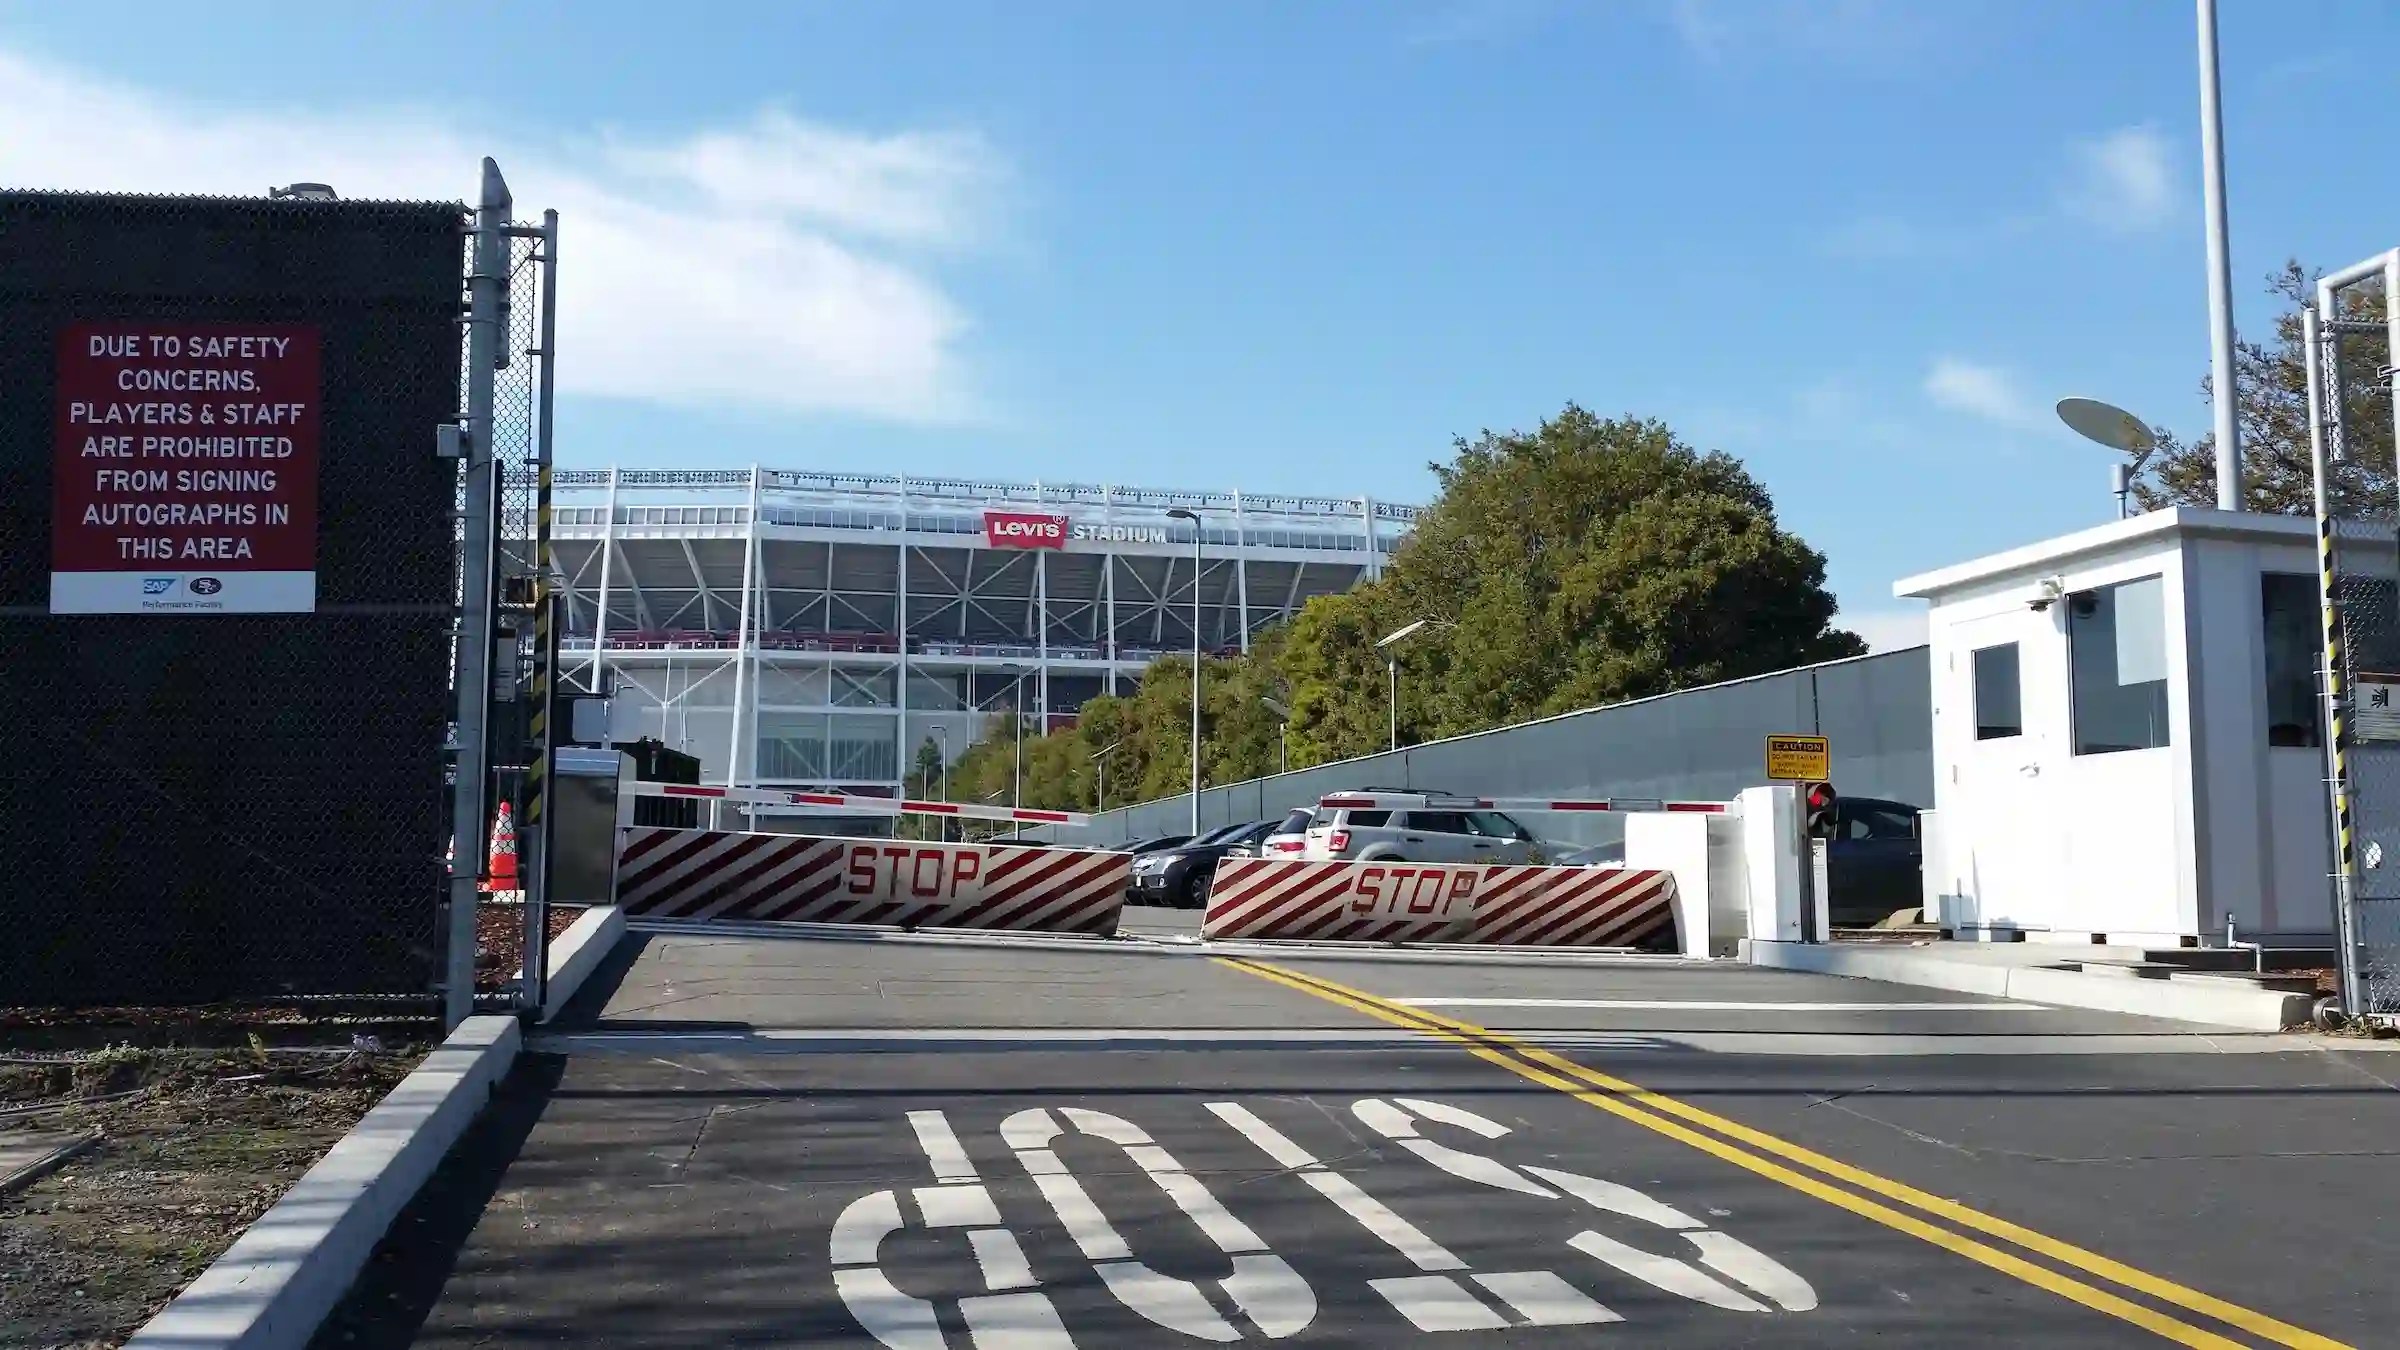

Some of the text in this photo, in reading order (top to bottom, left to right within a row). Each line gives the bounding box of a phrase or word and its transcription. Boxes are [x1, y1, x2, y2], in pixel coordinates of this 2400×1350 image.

[89, 335, 290, 358] DUE TO SAFETY
[117, 369, 262, 394] CONCERNS,
[69, 402, 306, 425] PLAYERS & STAFF
[80, 436, 293, 459] ARE PROHIBITED
[96, 470, 277, 492] FROM SIGNING
[81, 503, 290, 526] AUTOGRAPHS IN
[1072, 525, 1168, 544] STADIUM
[116, 537, 253, 560] THIS AREA
[144, 580, 171, 593] SAP
[1775, 743, 1821, 752] CAUTION
[848, 846, 981, 899] STOP
[1351, 868, 1479, 916] STOP
[830, 1096, 1818, 1350] STOP
